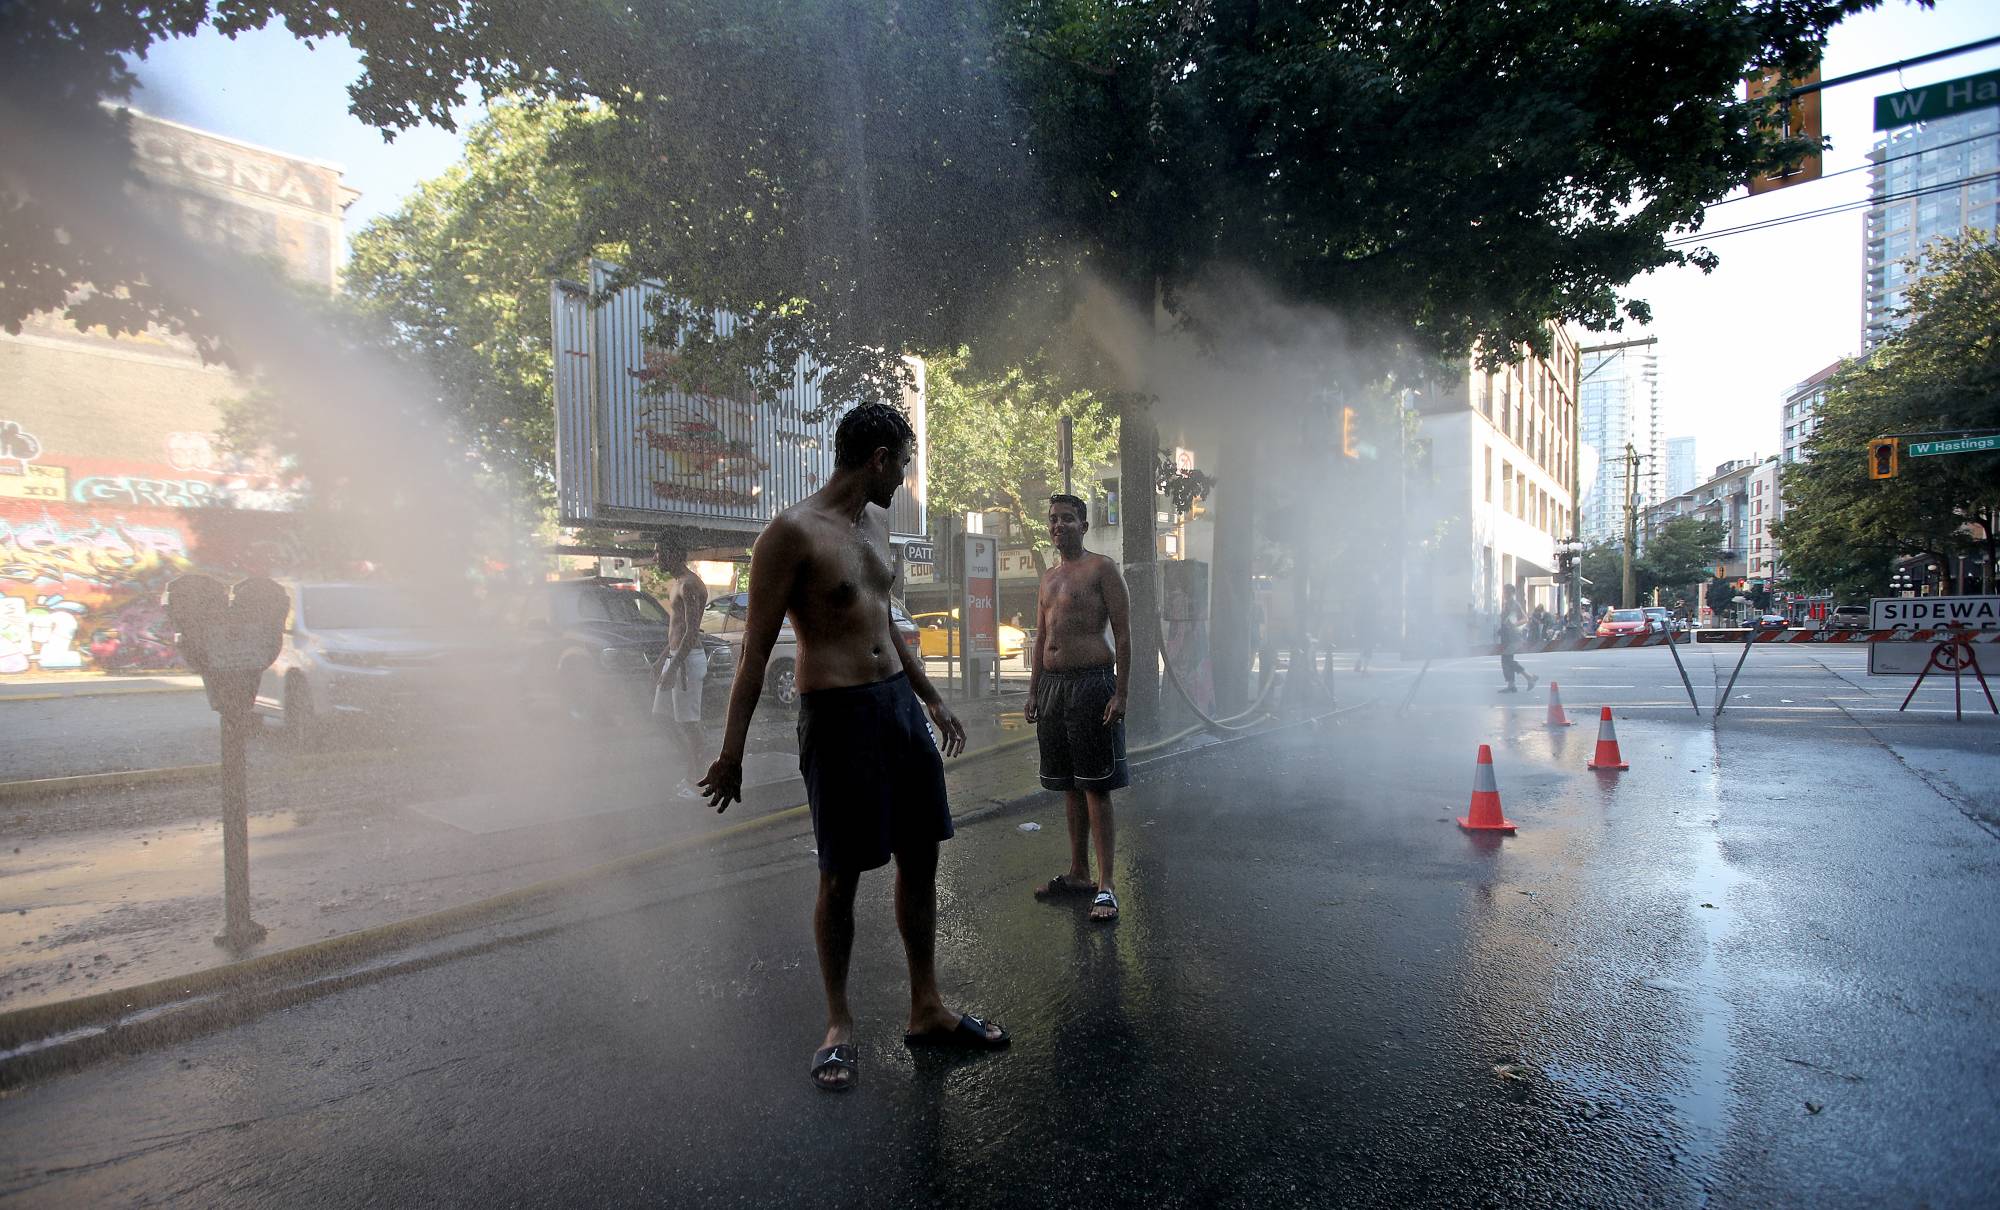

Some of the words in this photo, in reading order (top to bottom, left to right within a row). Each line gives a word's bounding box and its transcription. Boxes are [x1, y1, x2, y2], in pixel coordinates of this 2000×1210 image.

[1889, 90, 1928, 119] W
[1946, 79, 1998, 108] Ha
[1917, 444, 1930, 453] W
[1935, 439, 1995, 451] Hastings
[908, 545, 933, 560] PATT
[968, 595, 993, 608] Park
[1884, 602, 2000, 620] SIDEWA
